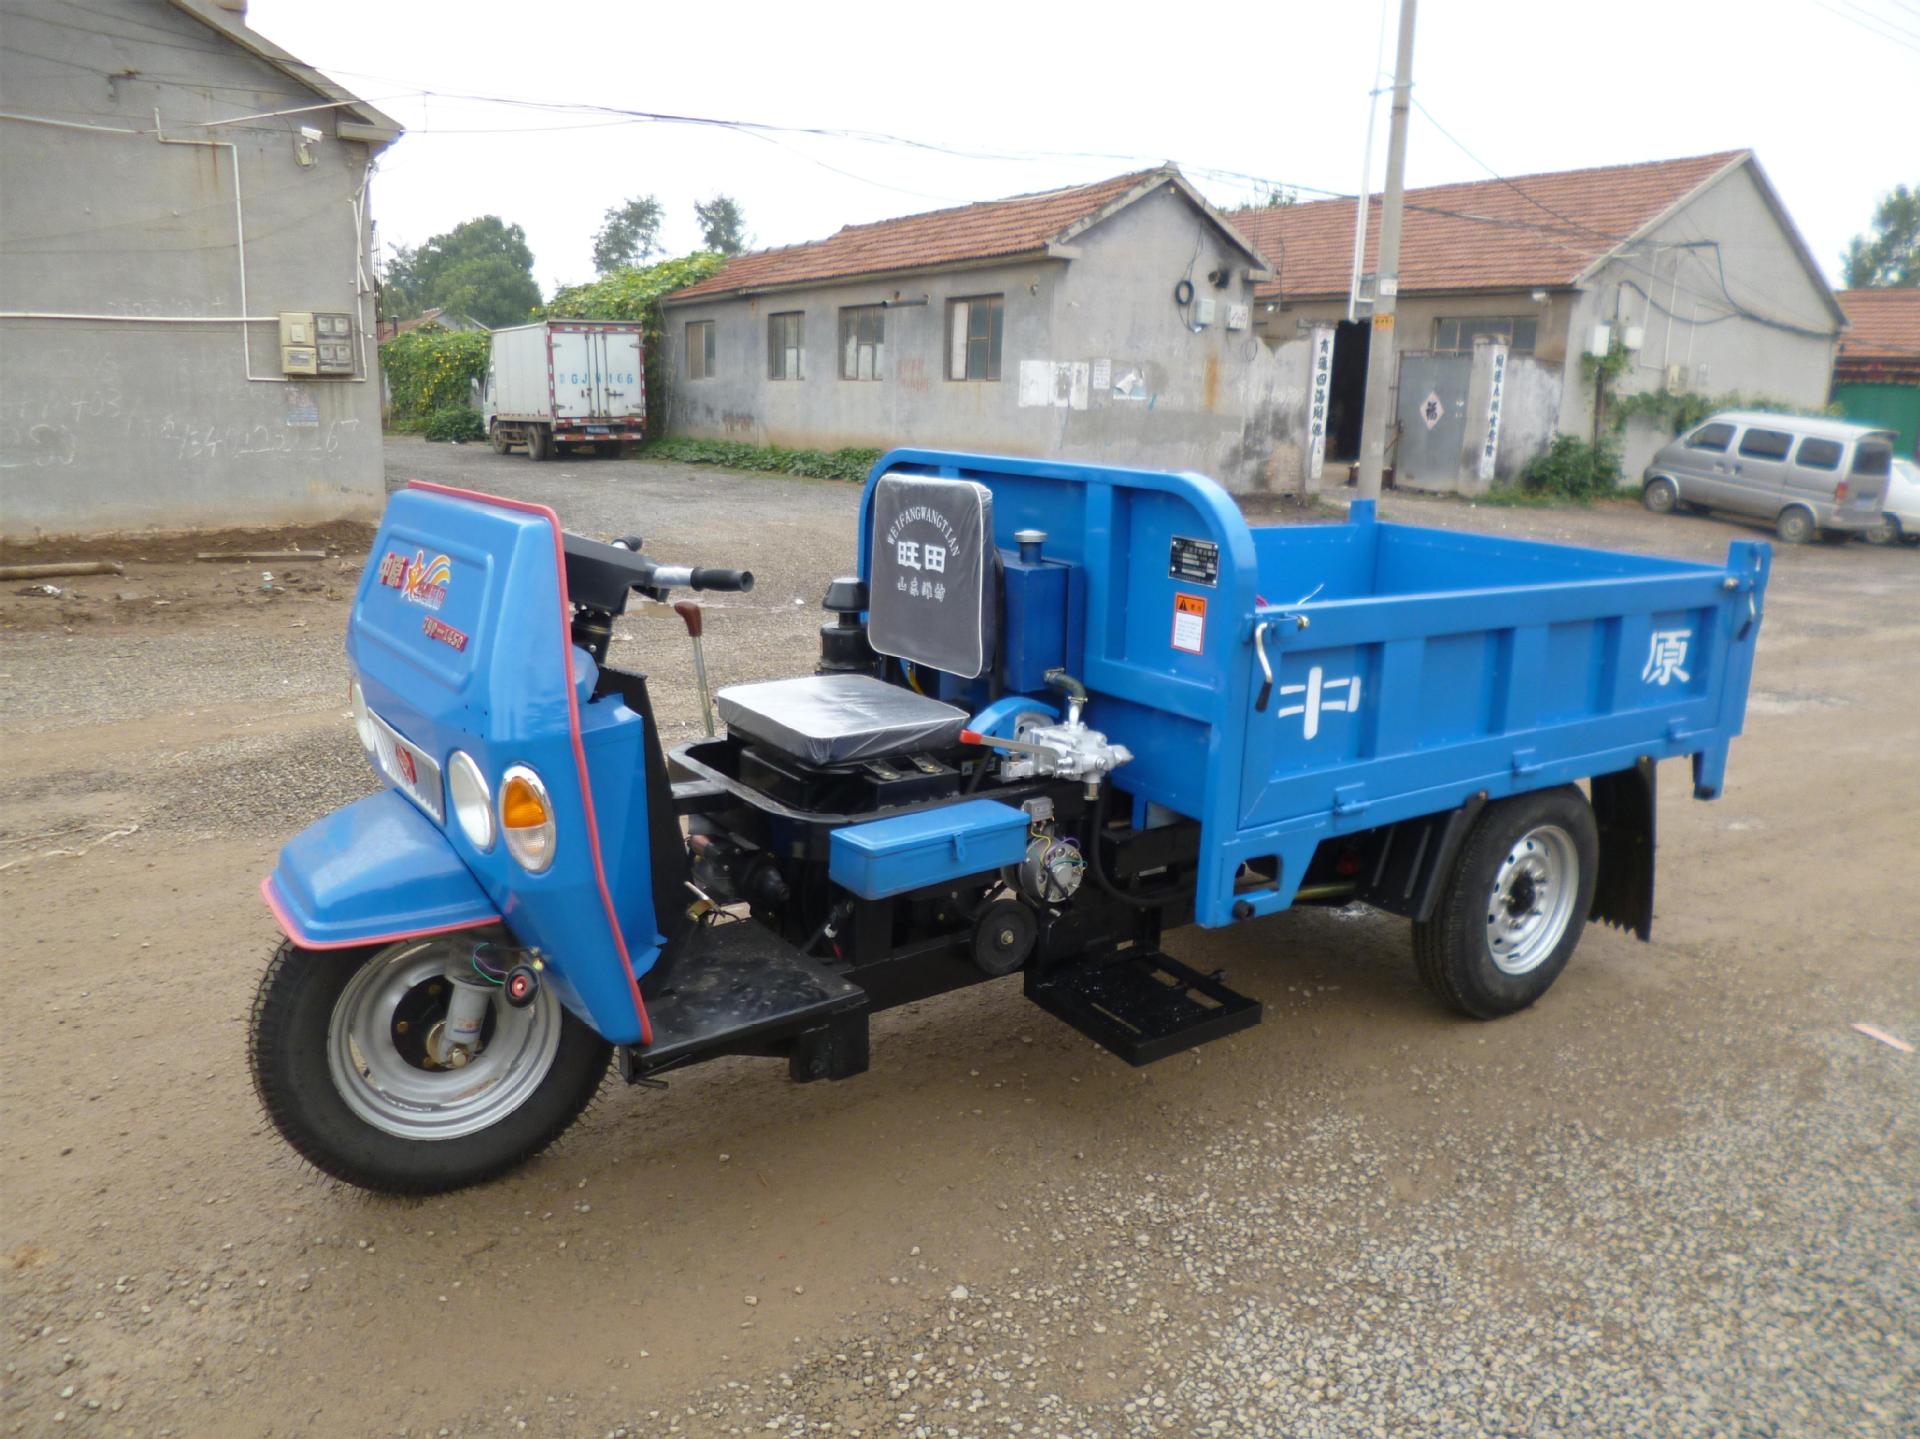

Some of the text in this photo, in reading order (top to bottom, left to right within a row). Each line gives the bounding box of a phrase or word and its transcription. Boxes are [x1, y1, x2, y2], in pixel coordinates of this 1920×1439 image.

[1426, 401, 1438, 420] 福
[887, 507, 960, 556] WEIFANGWANGTIAN
[380, 554, 408, 588] 中原
[898, 541, 946, 573] 旺田
[1642, 629, 1691, 686] 原
